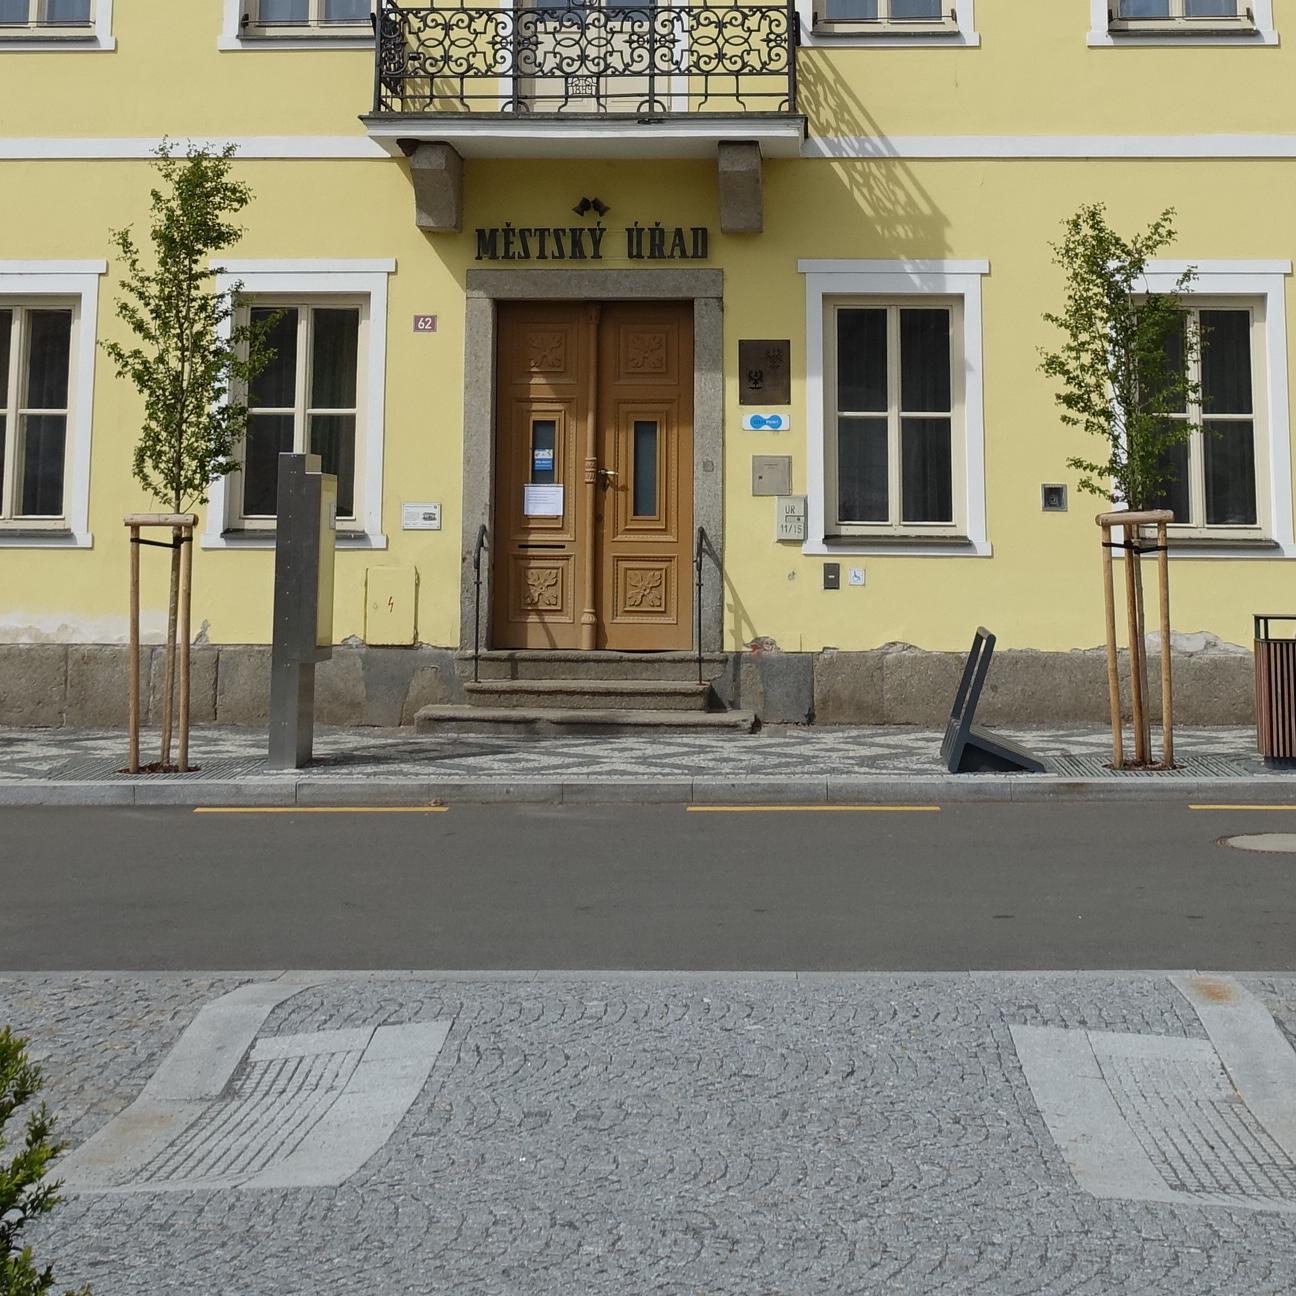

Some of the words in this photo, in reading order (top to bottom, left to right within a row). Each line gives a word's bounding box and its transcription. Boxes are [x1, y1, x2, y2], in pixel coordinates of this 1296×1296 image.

[475, 221, 607, 260] MĚSTSKÝ
[625, 221, 709, 259] ÚŘAD
[417, 317, 432, 329] 62
[780, 524, 802, 534] 11/15
